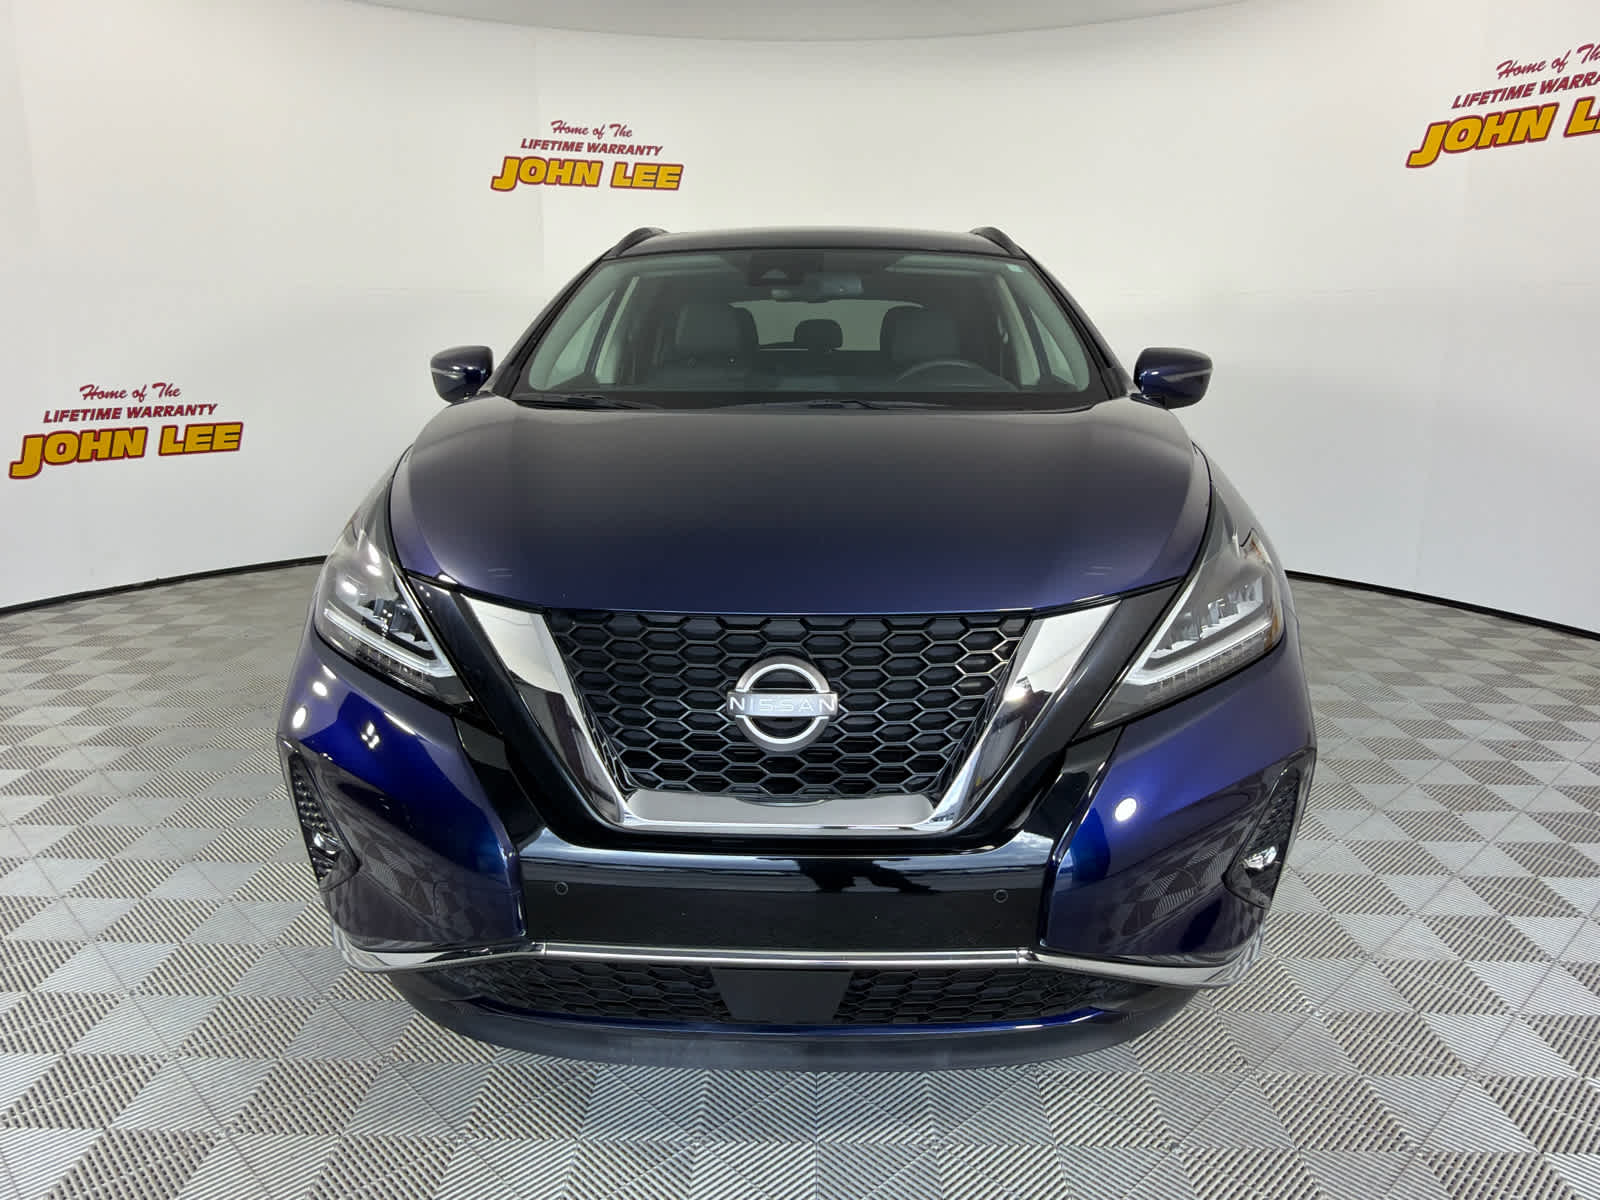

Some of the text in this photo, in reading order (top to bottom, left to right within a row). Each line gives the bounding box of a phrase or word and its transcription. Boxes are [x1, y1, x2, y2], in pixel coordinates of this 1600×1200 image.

[1496, 59, 1546, 80] Home
[1551, 49, 1571, 74] of
[1451, 71, 1600, 109] LIFETIME WARR
[550, 119, 633, 139] Home of The
[1406, 96, 1600, 168] JOHN L
[520, 138, 663, 157] LIFETIME WARRANTY
[490, 156, 684, 192] JOHN LEE
[79, 382, 181, 403] Home of The
[43, 403, 218, 424] LIFETIME WARRANTY
[9, 422, 243, 480] JOHN LEE
[729, 696, 836, 712] NISSAN
